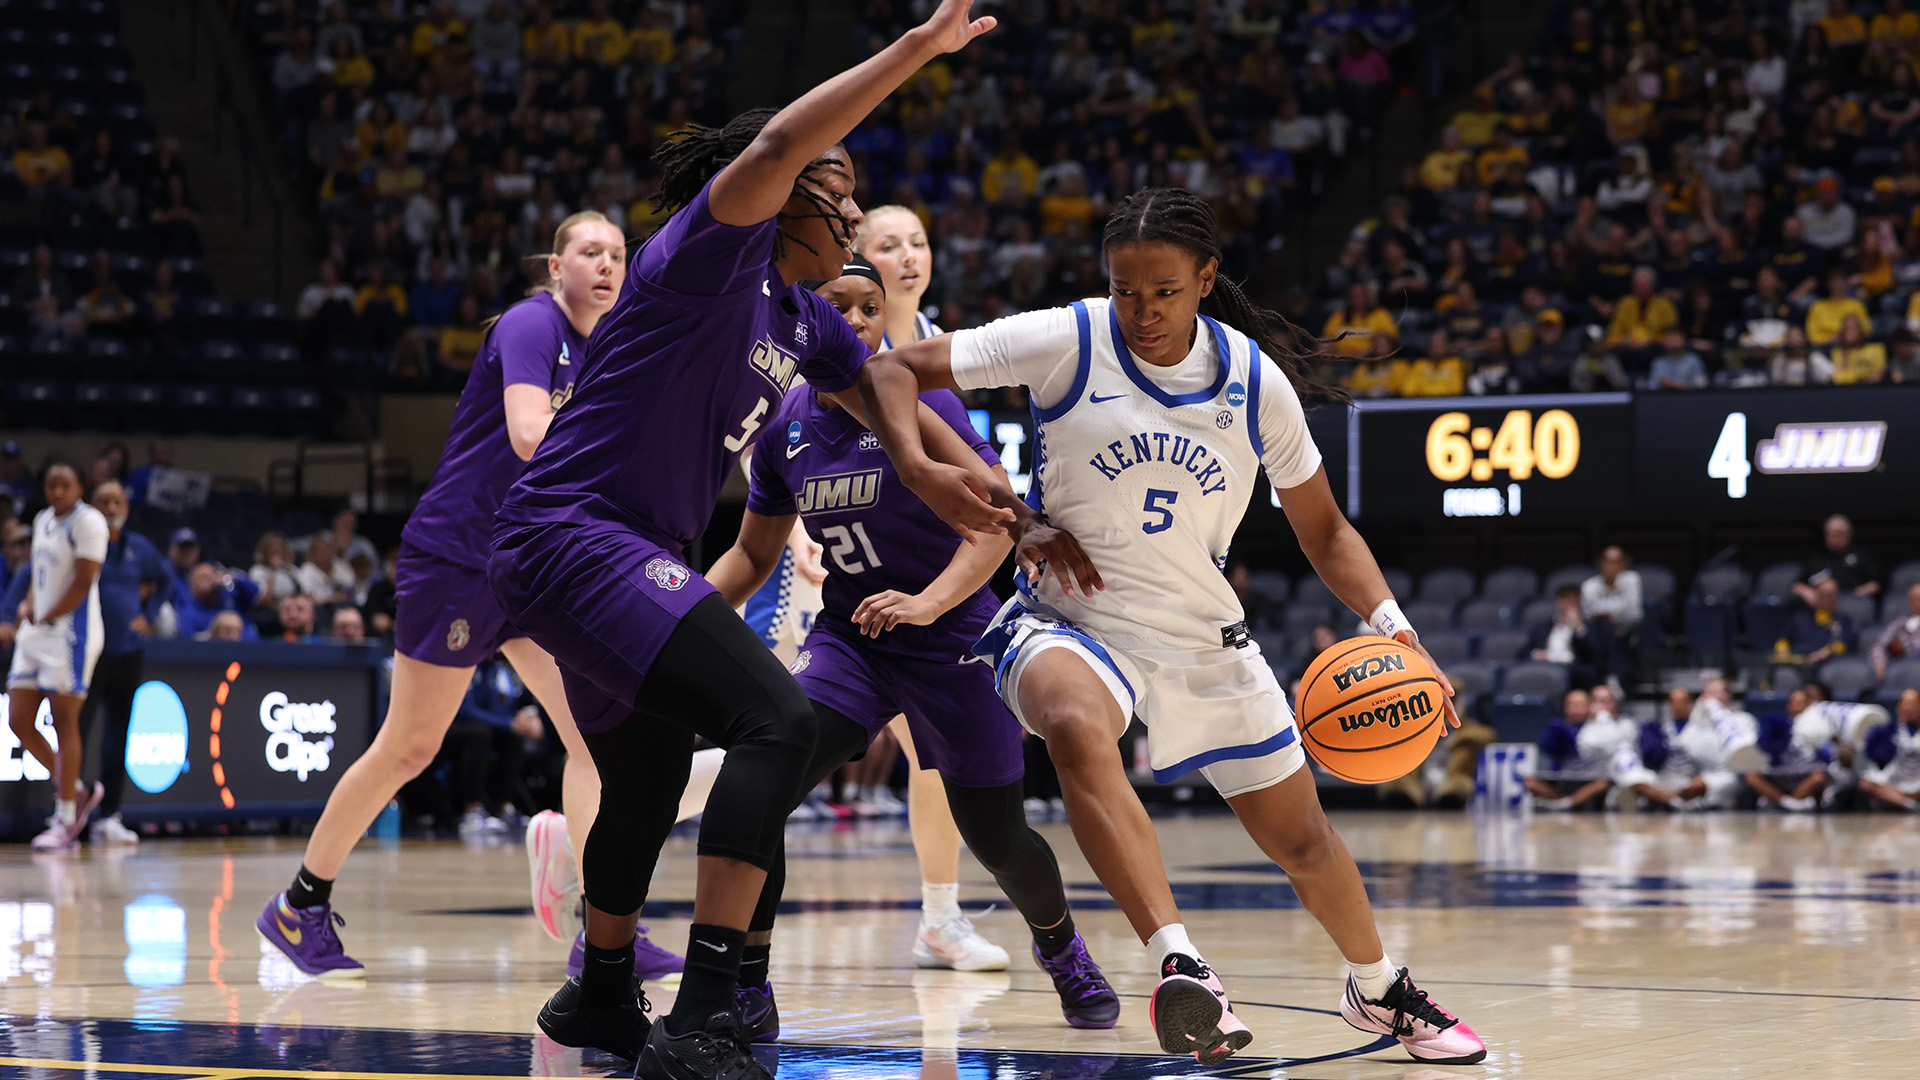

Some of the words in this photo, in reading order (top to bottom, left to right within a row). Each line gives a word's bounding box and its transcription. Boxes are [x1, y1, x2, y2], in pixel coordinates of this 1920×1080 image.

[751, 338, 798, 391] JM
[1227, 392, 1246, 401] NCAA
[723, 396, 770, 453] 5
[1216, 411, 1233, 429] SEC
[1090, 432, 1226, 496] KENTUCKY
[1425, 408, 1581, 482] 6:40
[1707, 411, 1751, 498] 4
[1757, 422, 1884, 472] JMU
[797, 472, 878, 513] JMU
[1142, 488, 1178, 534] 5
[821, 521, 883, 574] 21
[1332, 653, 1405, 692] NCAA
[259, 690, 337, 733] Great
[1337, 690, 1434, 732] Wilson
[1387, 693, 1402, 701] EVO
[265, 731, 330, 782] Clips
